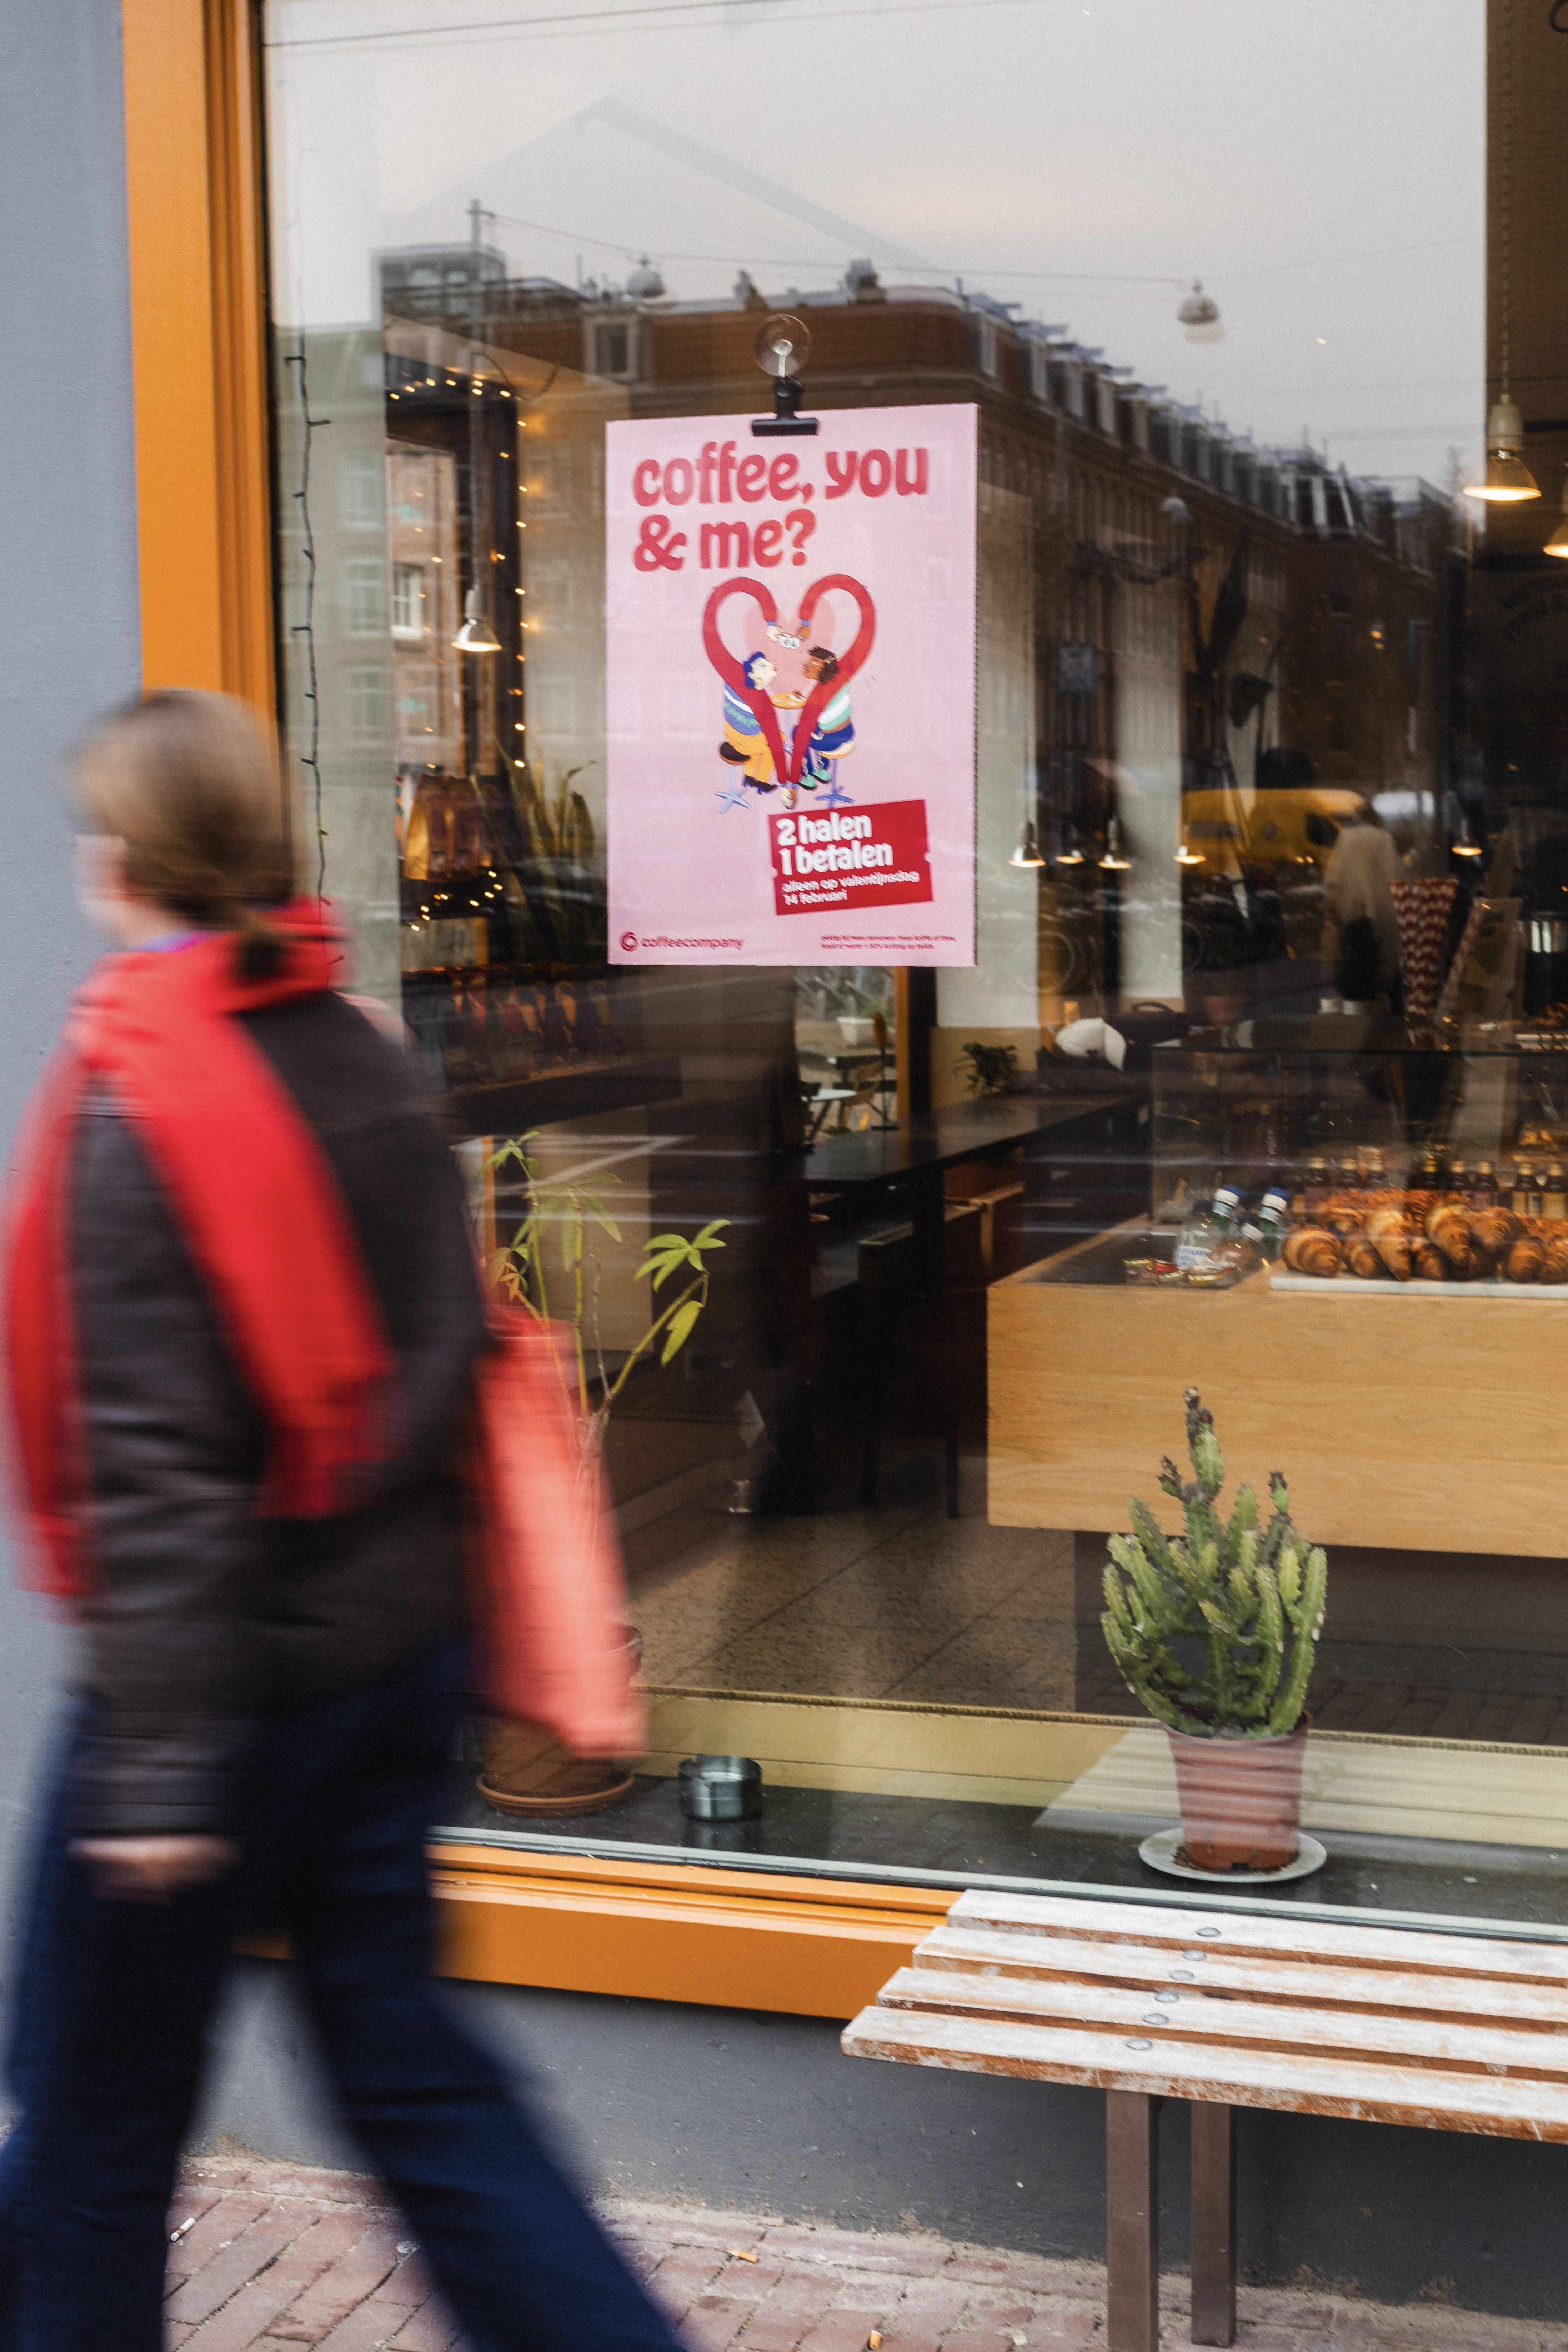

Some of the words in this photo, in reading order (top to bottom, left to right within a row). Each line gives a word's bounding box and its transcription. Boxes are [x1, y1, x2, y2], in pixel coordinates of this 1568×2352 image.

[633, 441, 813, 507] coffee,
[824, 448, 928, 500] you
[633, 515, 687, 572] &
[700, 509, 816, 569] me?
[776, 818, 797, 846] 2
[798, 811, 872, 844] halen
[778, 848, 793, 875] 1
[795, 840, 893, 874] betalen
[782, 880, 820, 892] alleen
[820, 879, 838, 890] op
[838, 870, 920, 886] valentijnsdag
[782, 894, 799, 905] 14
[799, 889, 848, 904] februari
[641, 935, 744, 950] coffeecompany
